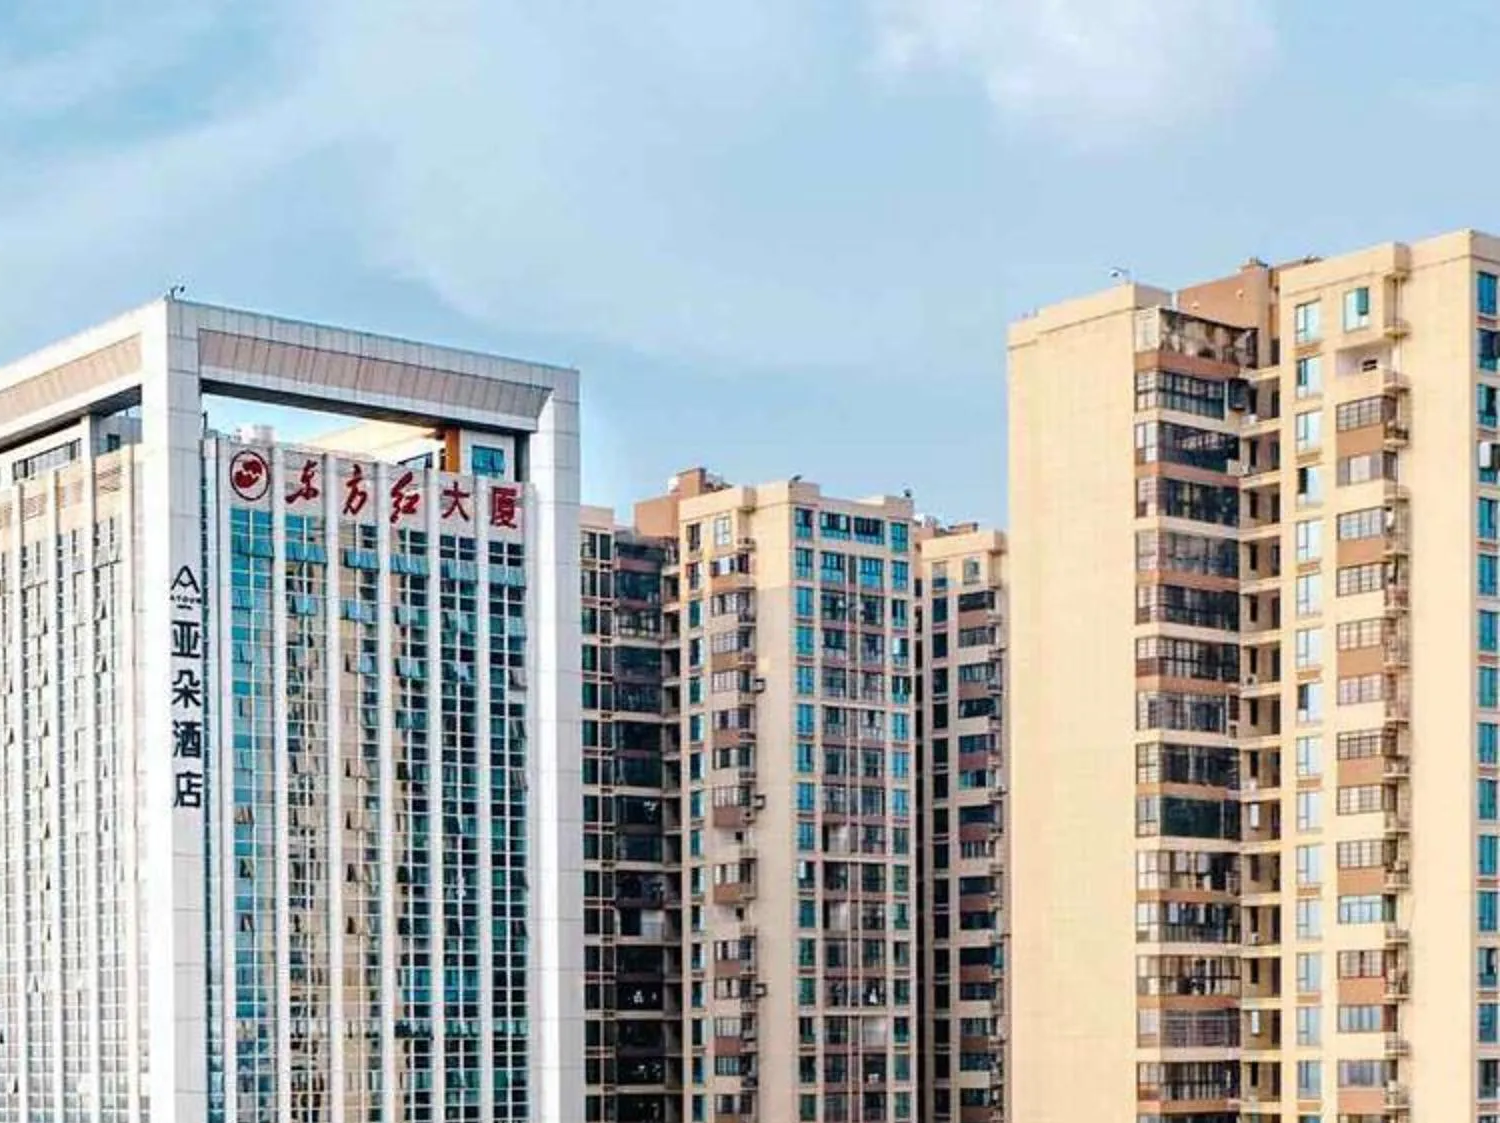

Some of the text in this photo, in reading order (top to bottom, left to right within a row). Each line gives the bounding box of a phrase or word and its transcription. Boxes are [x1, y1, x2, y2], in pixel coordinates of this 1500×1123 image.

[285, 459, 518, 529] 东方红大厦
[171, 619, 202, 809] 亚朵酒店
